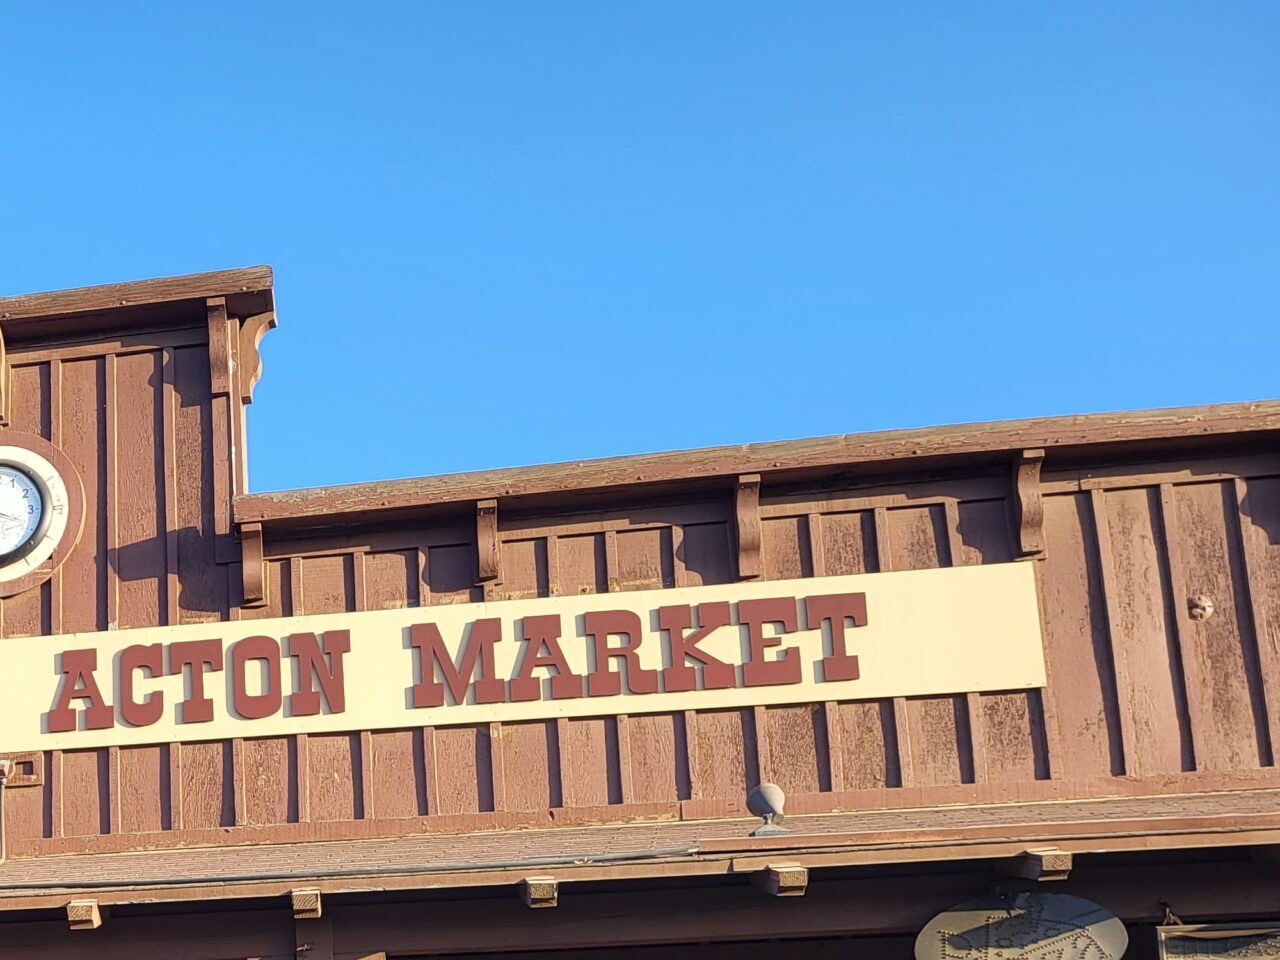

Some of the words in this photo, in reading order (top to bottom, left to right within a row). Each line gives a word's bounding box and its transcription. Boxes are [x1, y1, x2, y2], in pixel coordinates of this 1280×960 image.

[9, 478, 16, 489] 1
[22, 488, 30, 499] 2
[27, 504, 35, 515] 3
[47, 629, 351, 735] ACTON
[408, 592, 868, 710] MARKET
